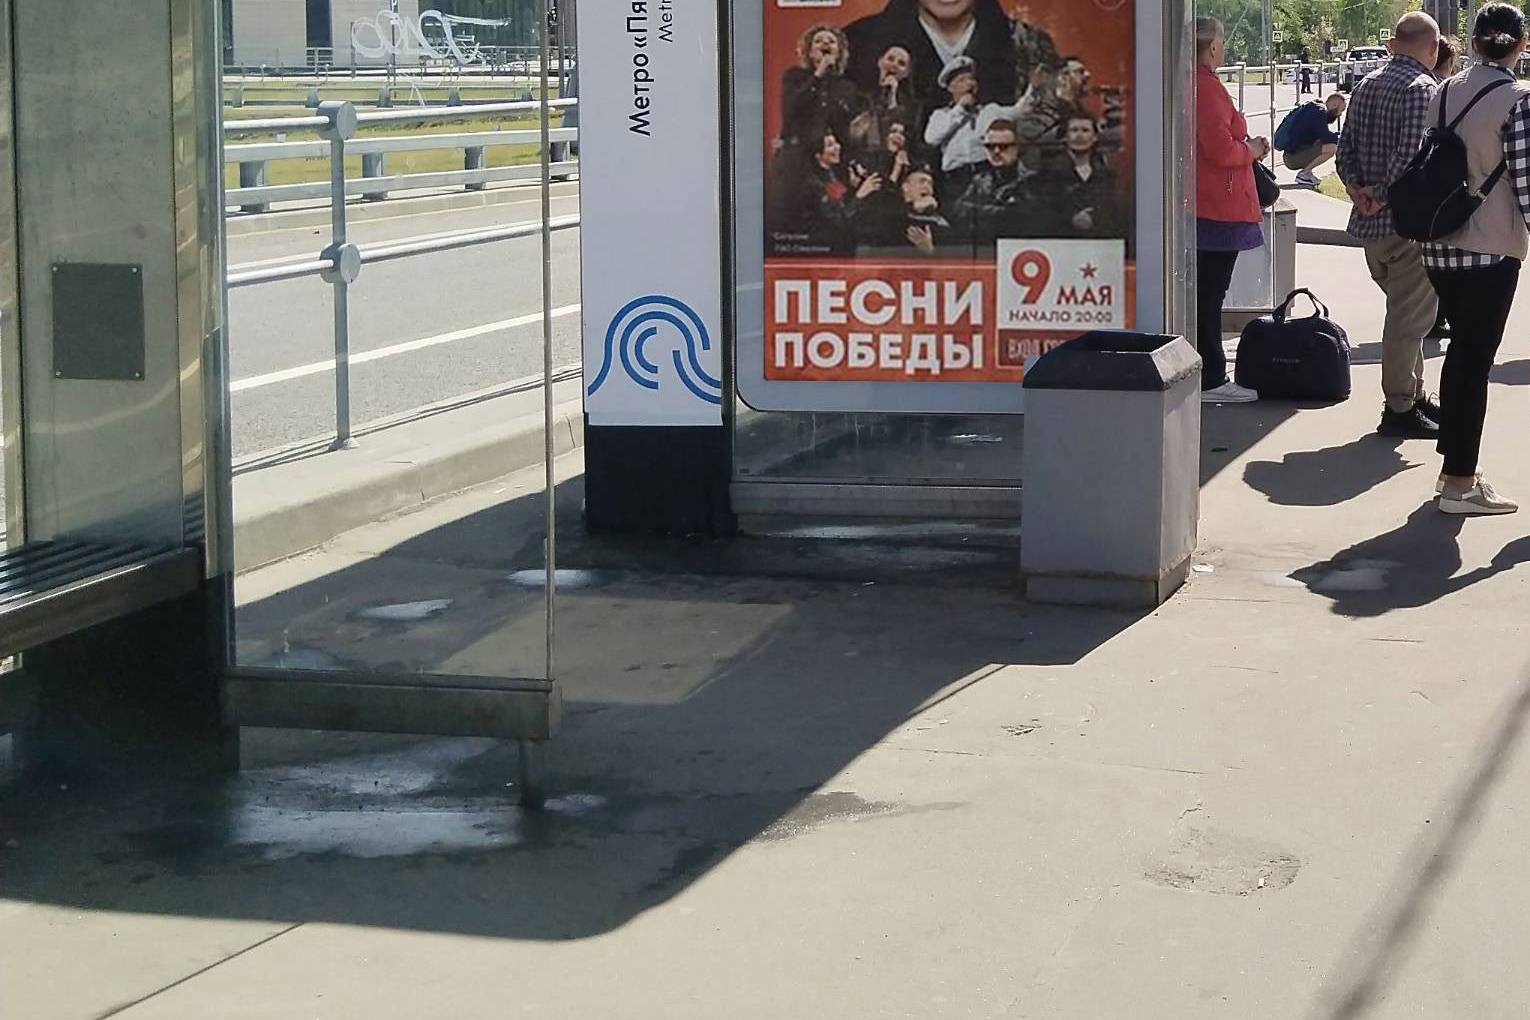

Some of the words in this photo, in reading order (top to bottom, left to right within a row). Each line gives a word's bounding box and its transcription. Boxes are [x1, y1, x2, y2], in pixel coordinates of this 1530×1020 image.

[627, 52, 655, 138] Метро
[1010, 249, 1051, 305] 9
[1056, 284, 1112, 306] МАЯ
[774, 278, 984, 326] ПЕСНИ
[1008, 309, 1072, 323] НАЧАЛО
[774, 331, 984, 374] ПОБЕДЫ
